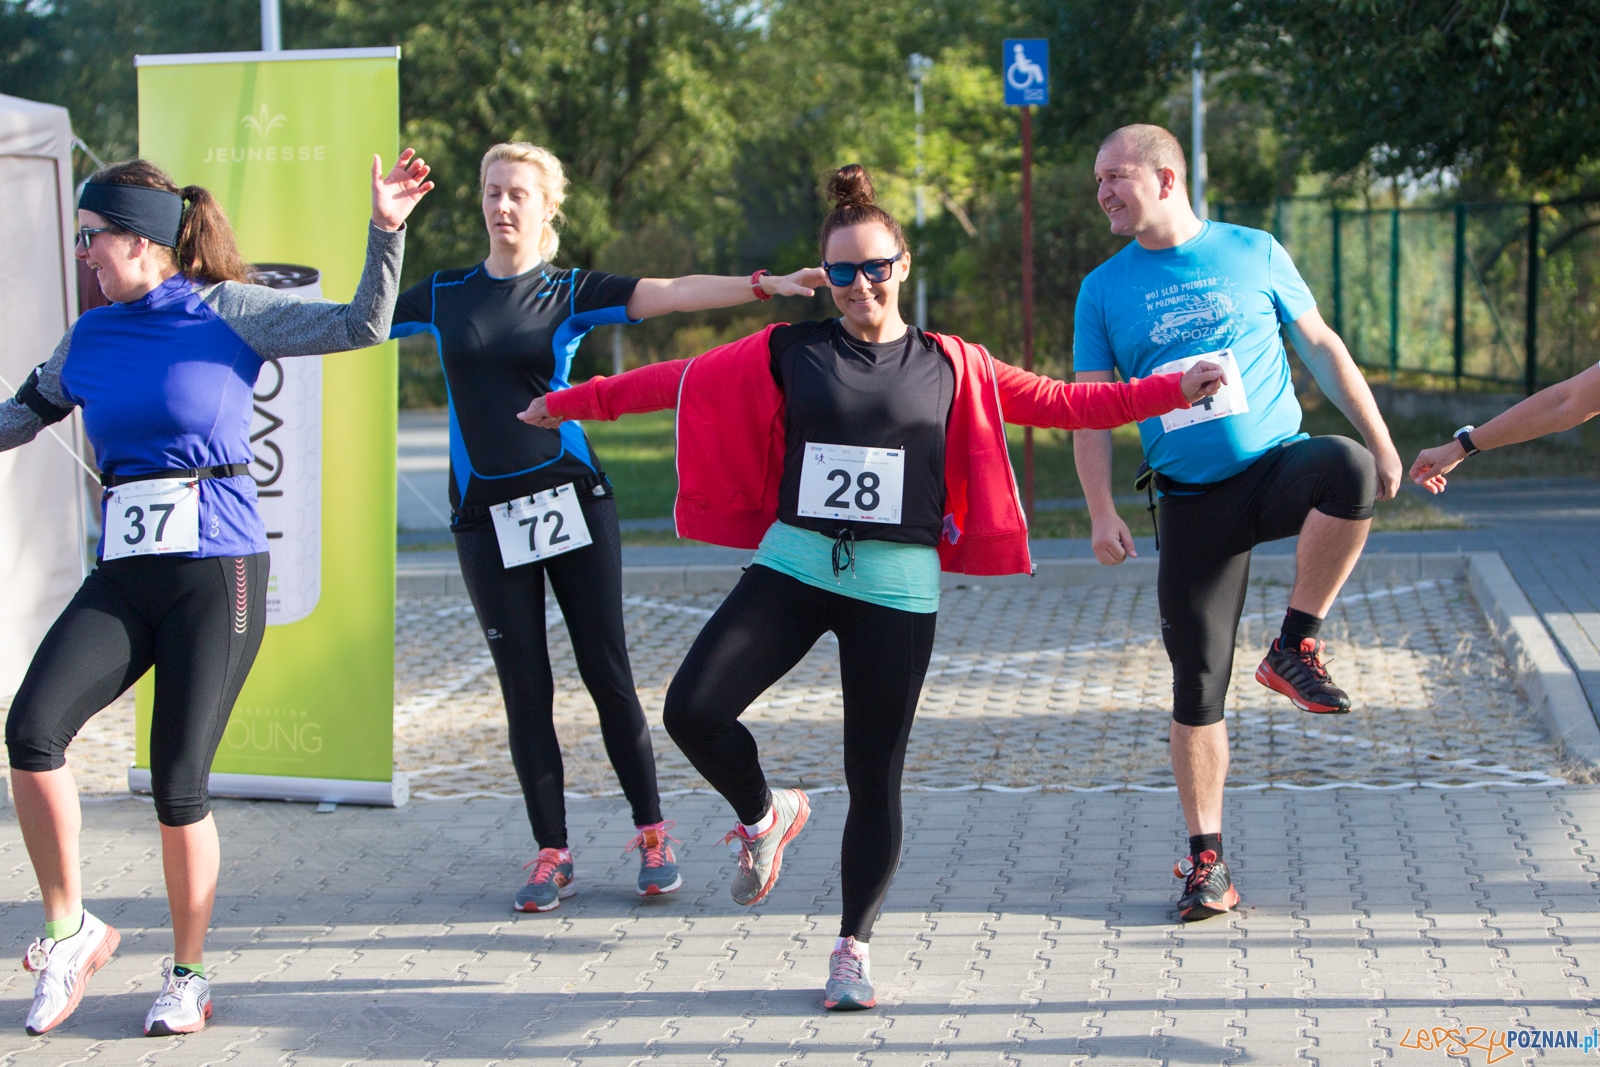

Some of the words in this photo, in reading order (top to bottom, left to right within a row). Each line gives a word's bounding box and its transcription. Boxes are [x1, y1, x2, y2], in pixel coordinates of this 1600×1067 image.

[203, 146, 326, 163] JEUNESSE
[1147, 302, 1154, 312] W
[824, 469, 880, 511] 28
[124, 503, 175, 545] 37
[518, 510, 571, 552] 72
[236, 706, 307, 718] NERATION
[225, 719, 321, 753] OUNG
